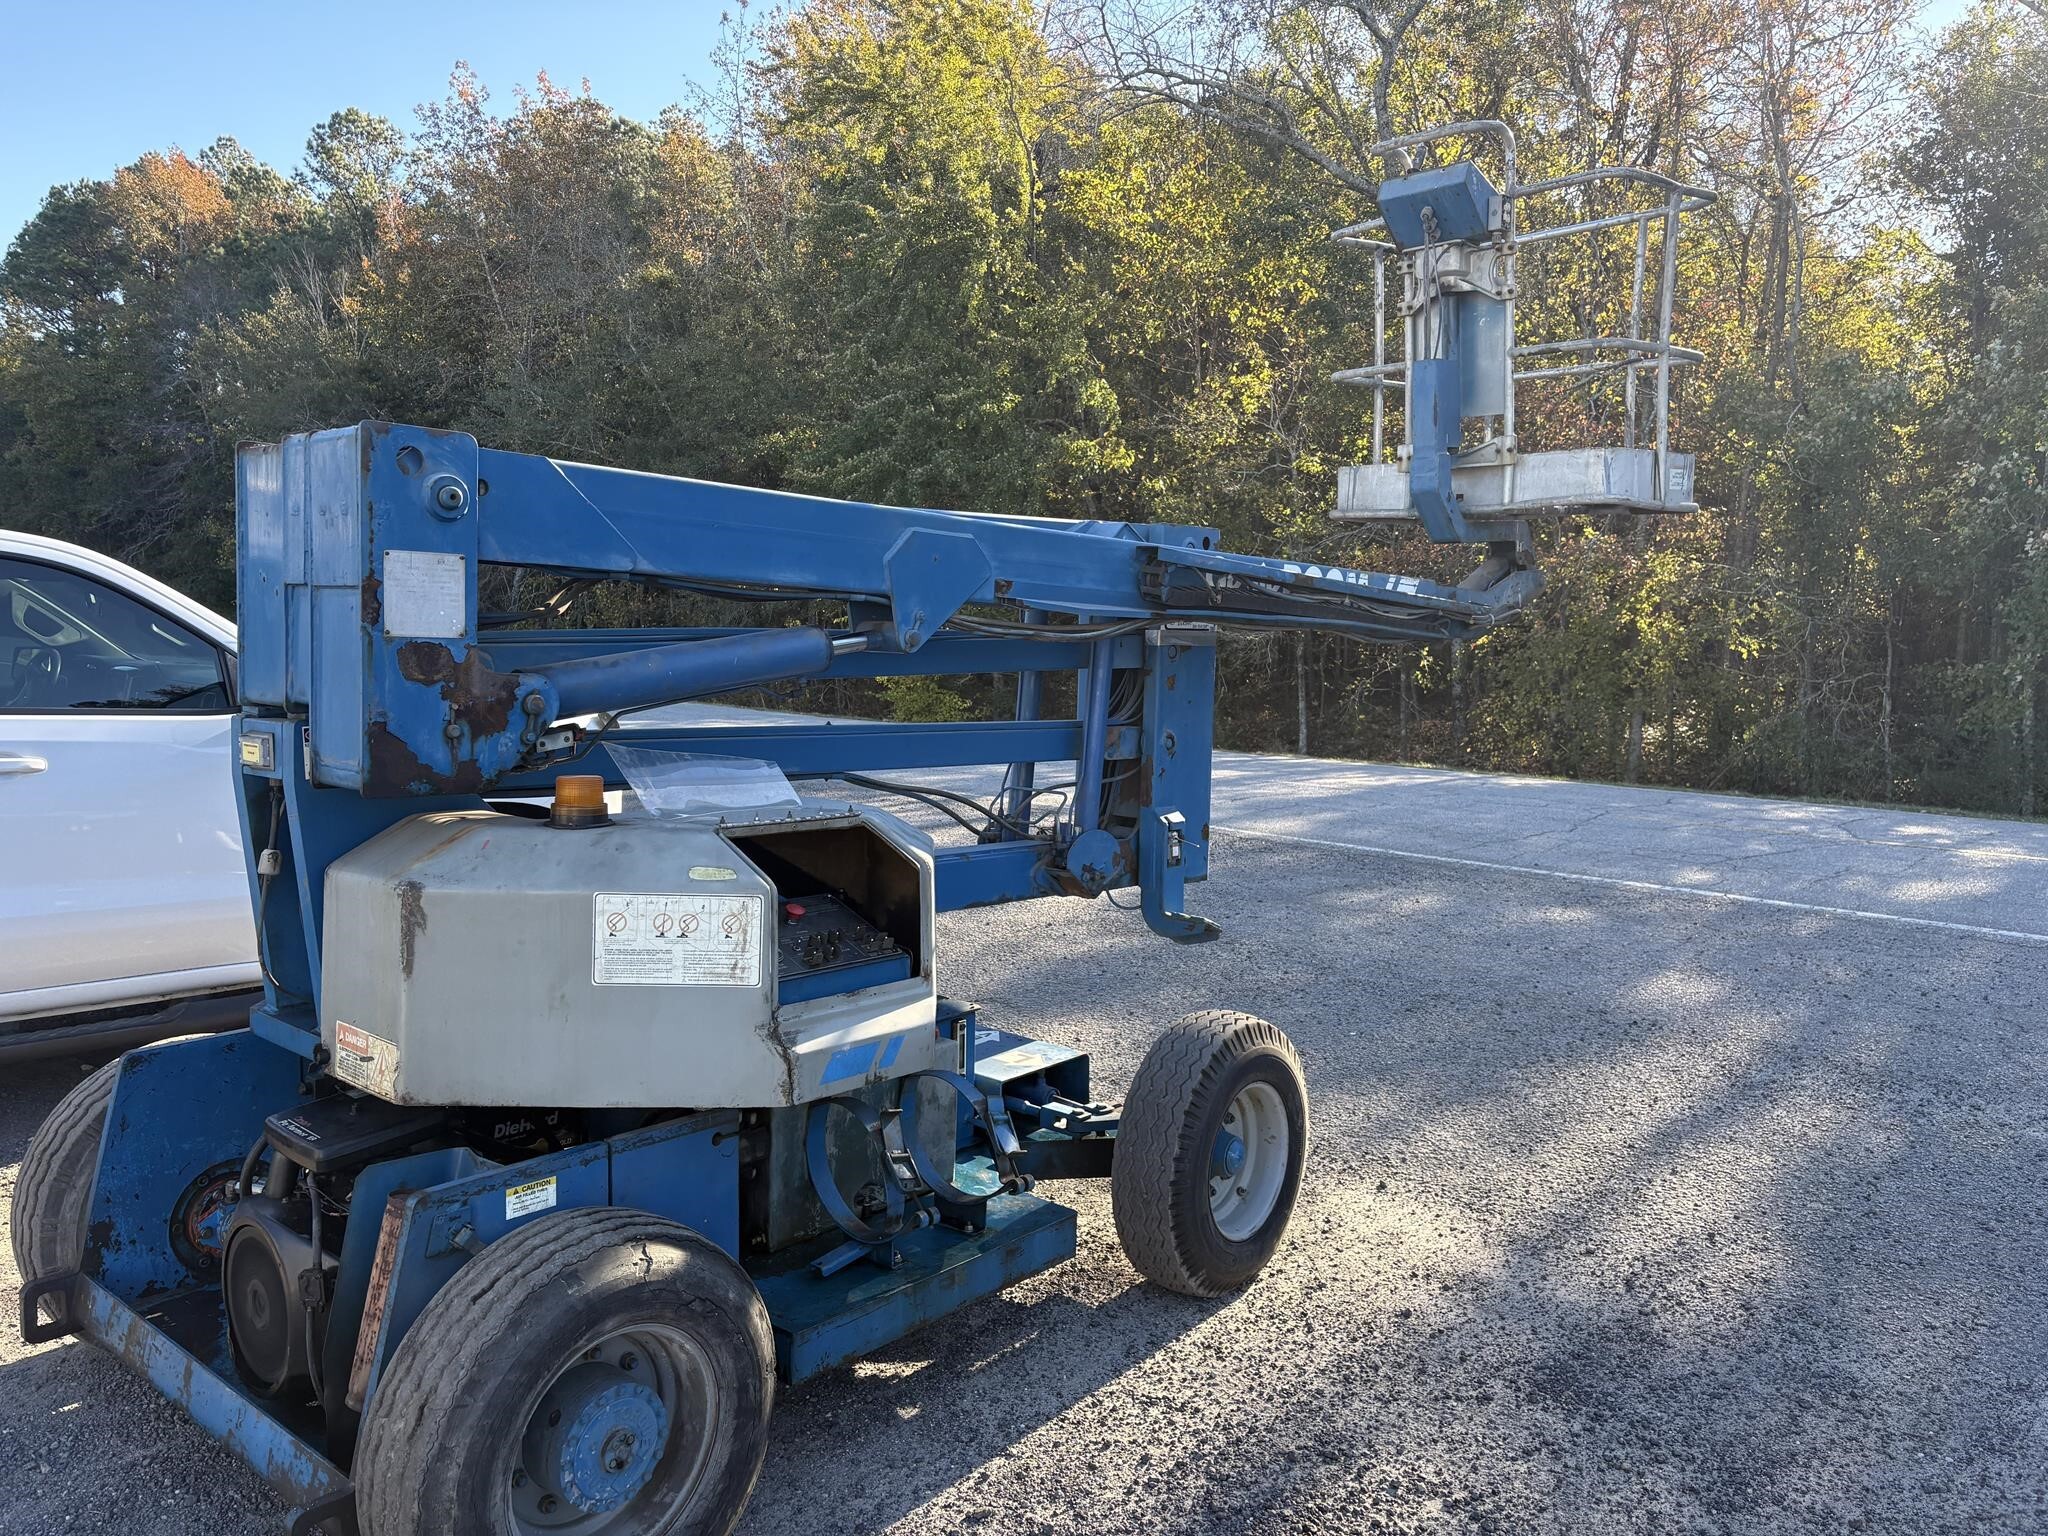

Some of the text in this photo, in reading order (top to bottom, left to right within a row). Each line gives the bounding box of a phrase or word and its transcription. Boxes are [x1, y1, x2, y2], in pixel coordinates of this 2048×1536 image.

[345, 1031, 367, 1050] DANGER
[494, 1110, 559, 1139] Diehd
[522, 1179, 551, 1192] CAUTION
